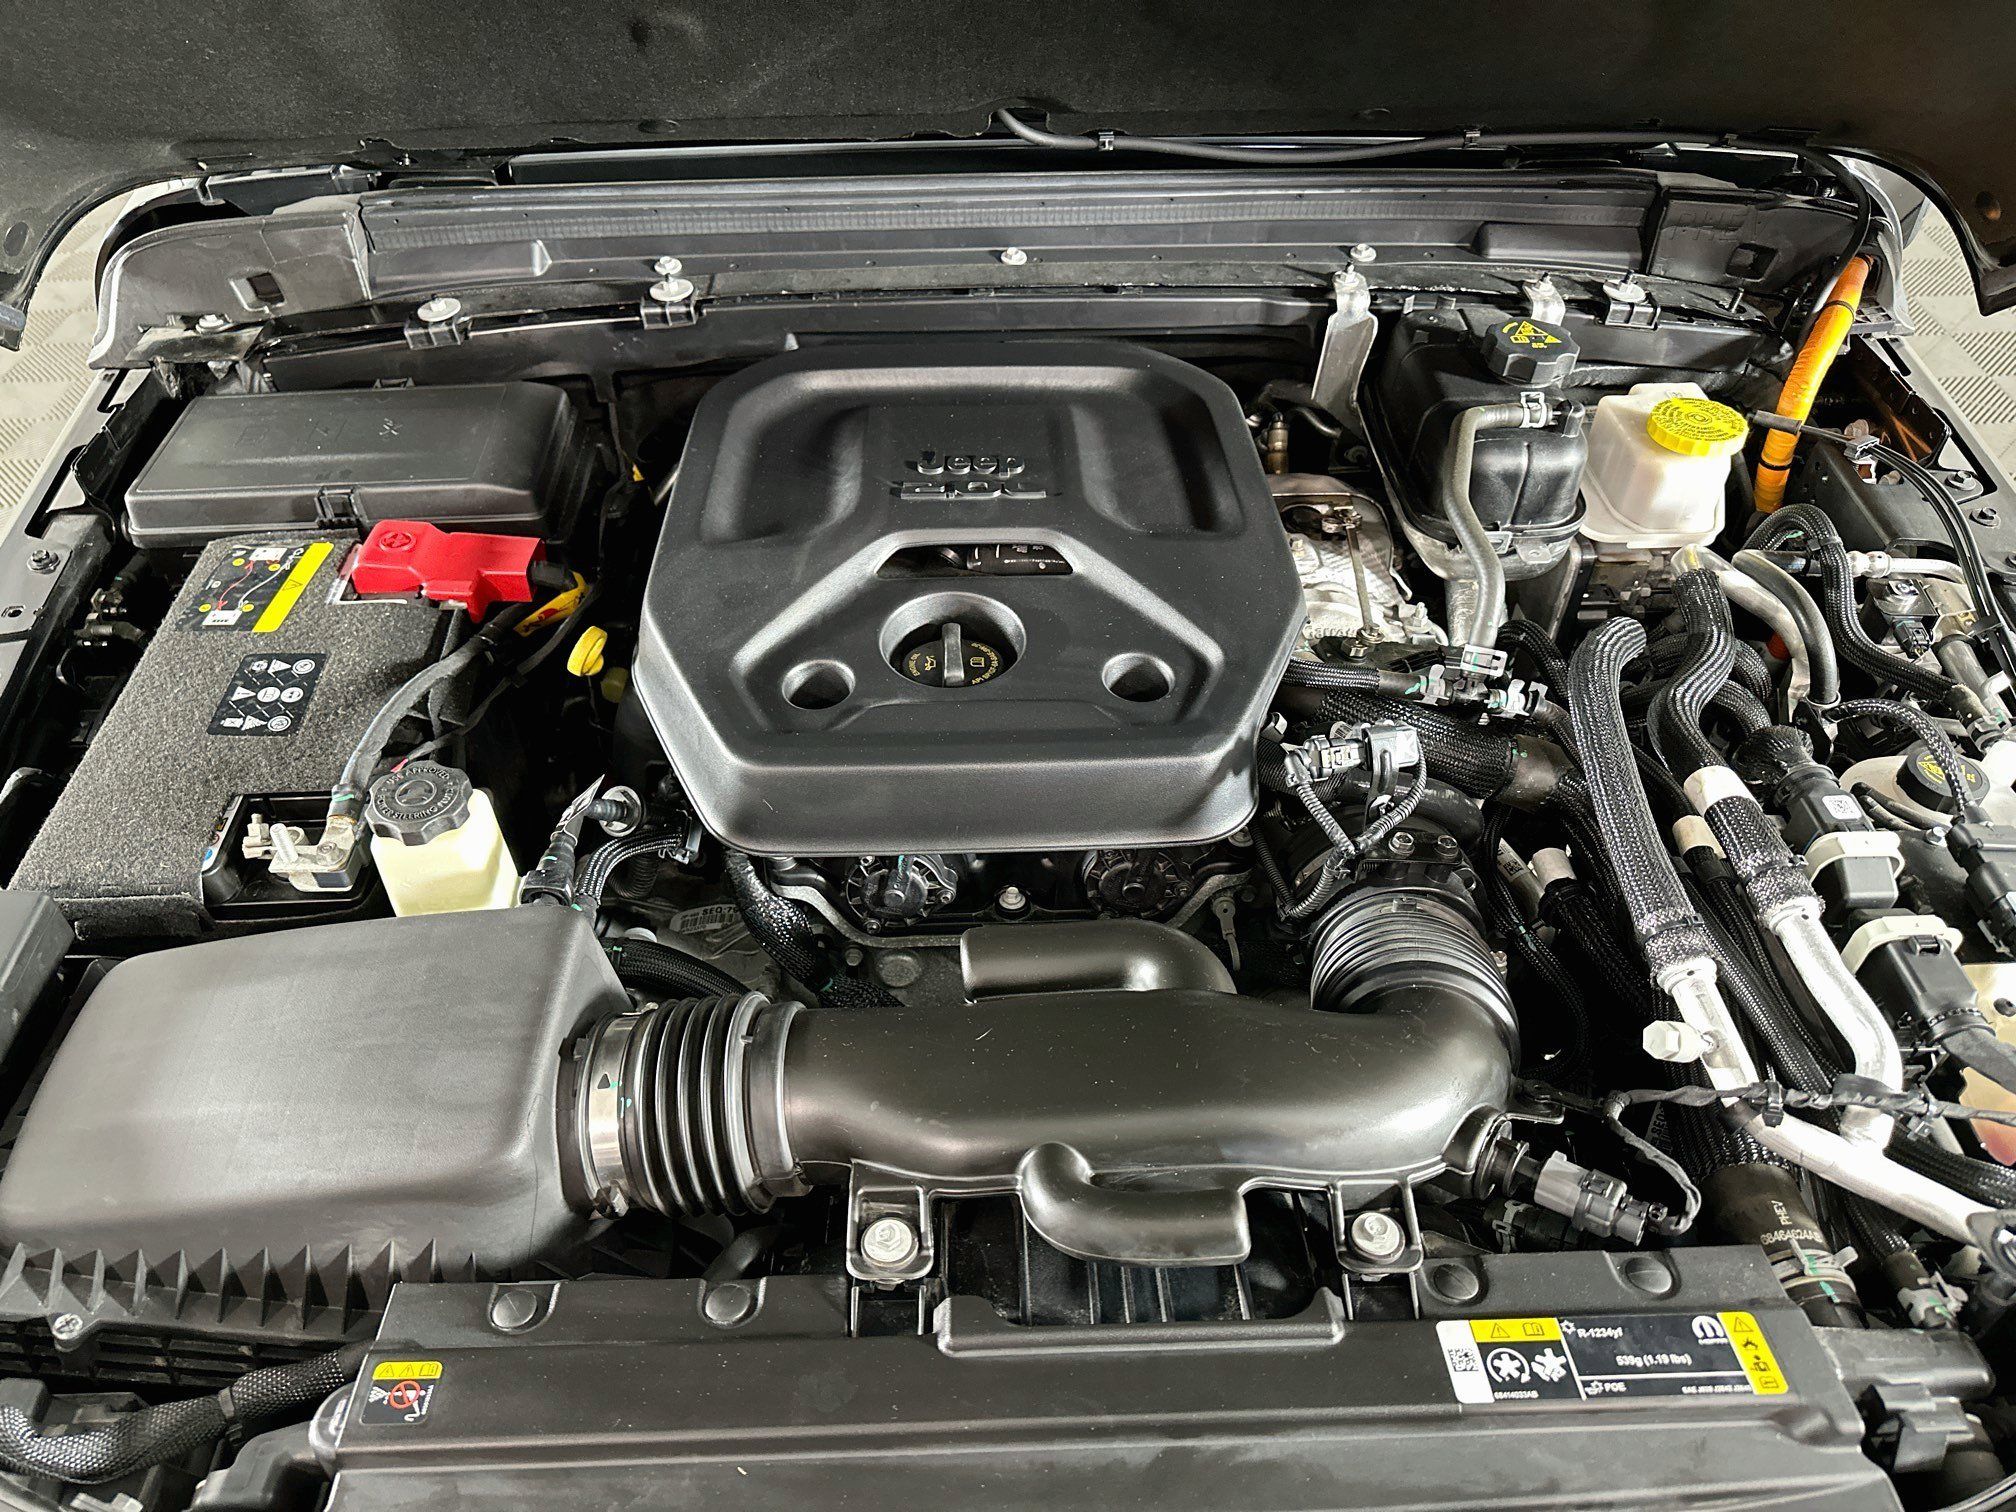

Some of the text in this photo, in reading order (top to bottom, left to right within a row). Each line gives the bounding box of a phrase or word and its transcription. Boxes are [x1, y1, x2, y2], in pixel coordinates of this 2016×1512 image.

[916, 450, 1026, 478] Jeep
[386, 767, 450, 785] USE APPROVED
[377, 794, 395, 817] POWER
[392, 804, 438, 820] STEERING
[1771, 1200, 1792, 1226] PHEV
[1604, 1382, 1627, 1392] POE
